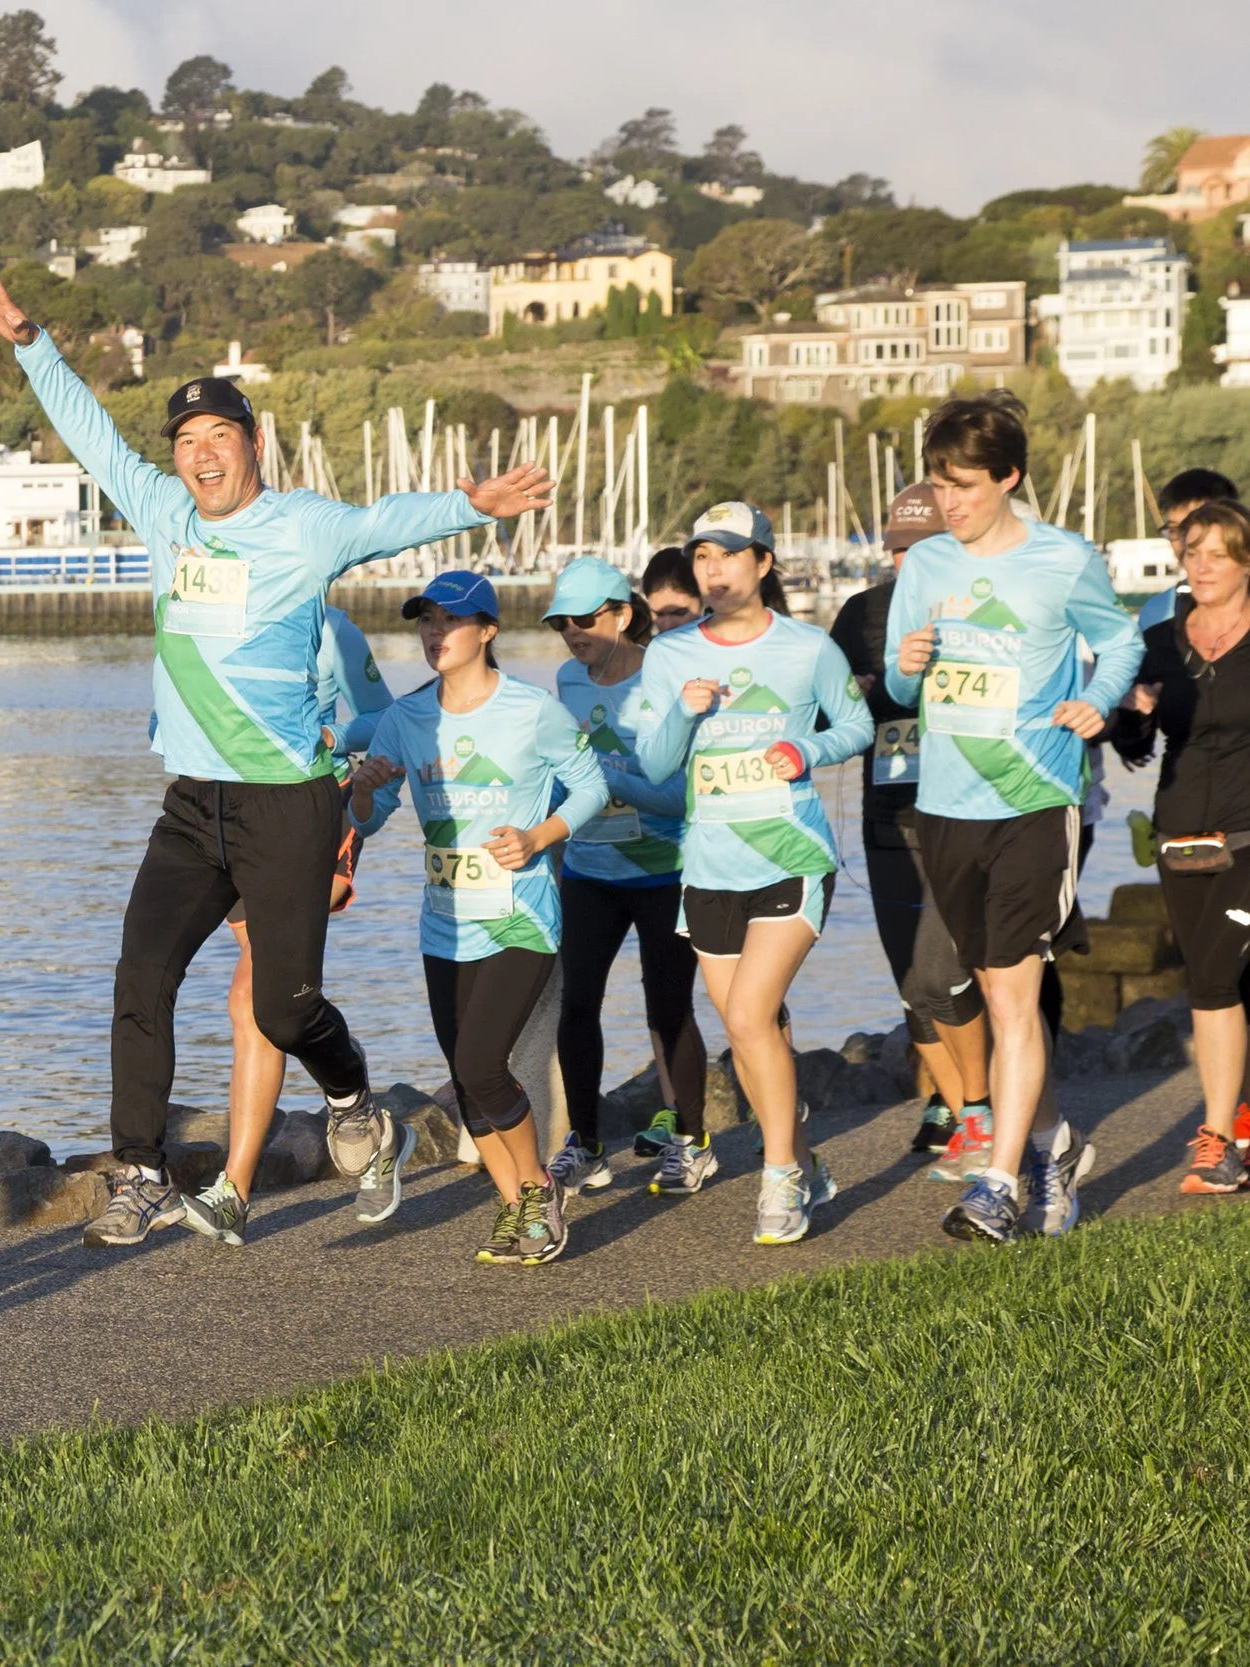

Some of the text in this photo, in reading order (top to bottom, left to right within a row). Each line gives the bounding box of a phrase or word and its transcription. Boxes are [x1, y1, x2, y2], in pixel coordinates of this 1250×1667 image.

[895, 506, 933, 516] COVE
[941, 631, 1022, 653] IBURON
[956, 670, 1009, 698] 747
[426, 789, 509, 807] TIBURON
